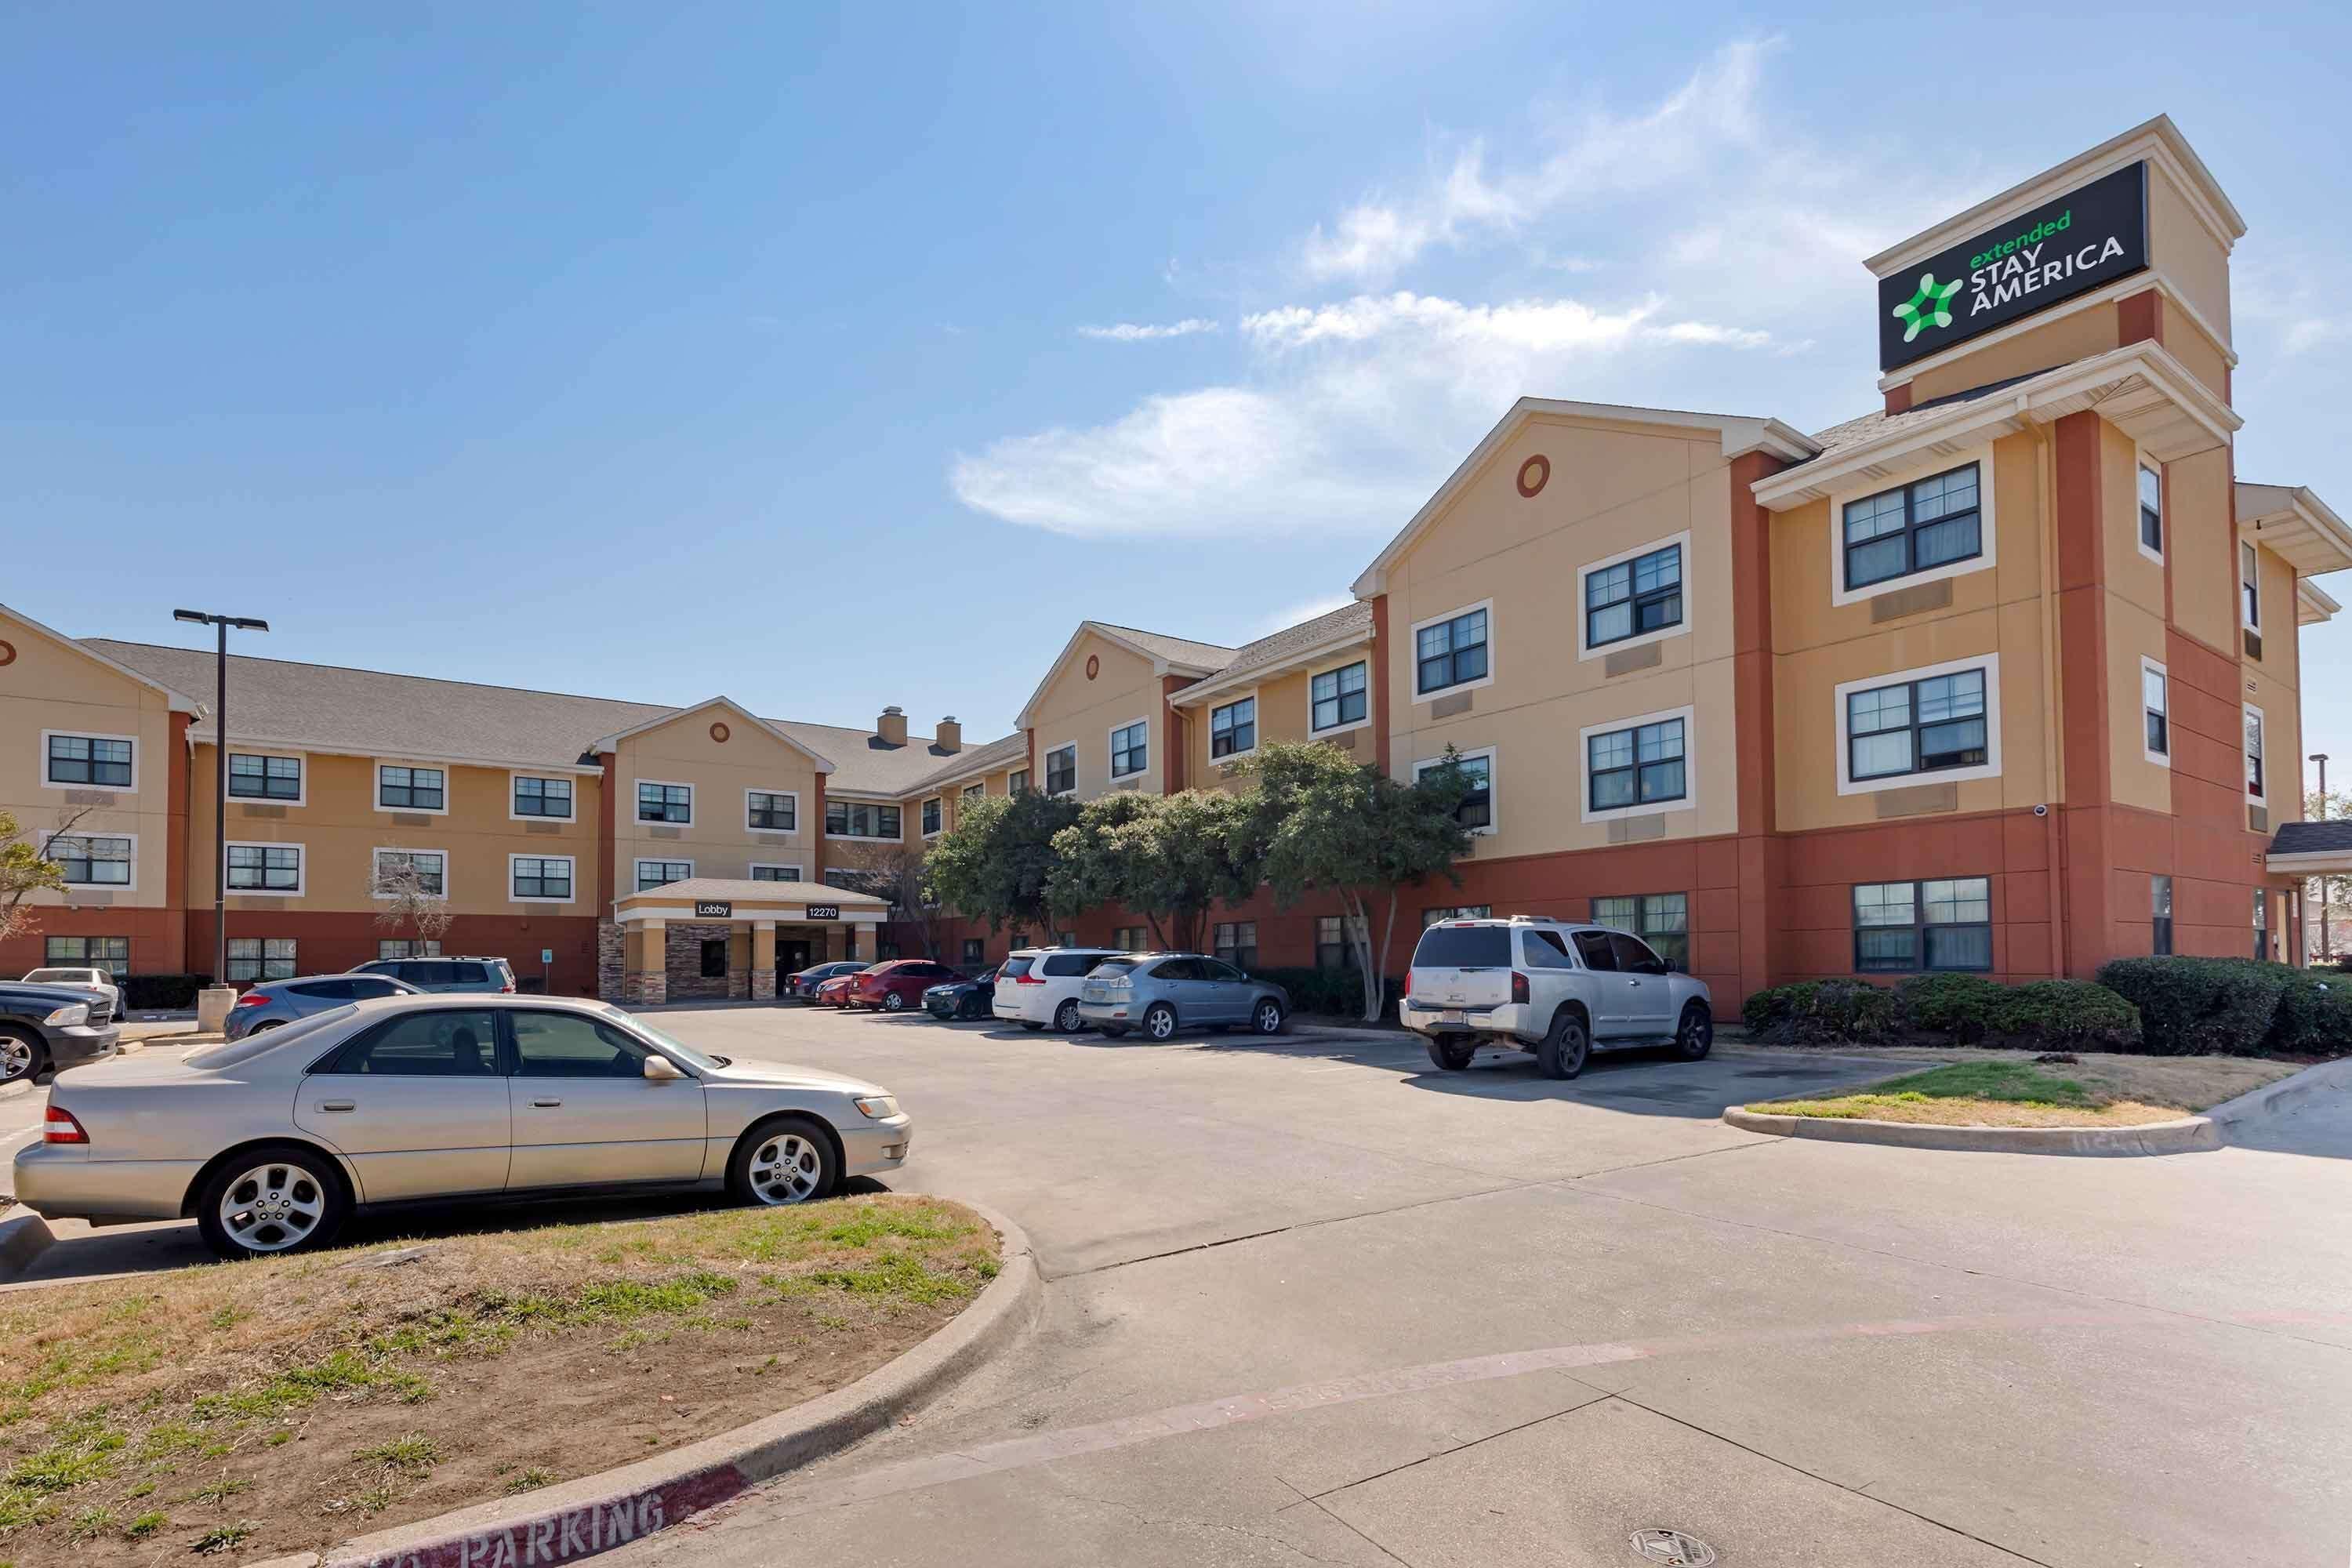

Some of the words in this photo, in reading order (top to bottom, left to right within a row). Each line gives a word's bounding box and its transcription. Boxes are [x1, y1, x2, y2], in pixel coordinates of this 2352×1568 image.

[1970, 209, 2071, 268] extended
[1970, 236, 2125, 317] AMERICA
[1971, 242, 2043, 293] STAY
[699, 905, 728, 916] Lobby
[809, 908, 837, 916] 12270
[459, 1491, 664, 1568] PARKING
